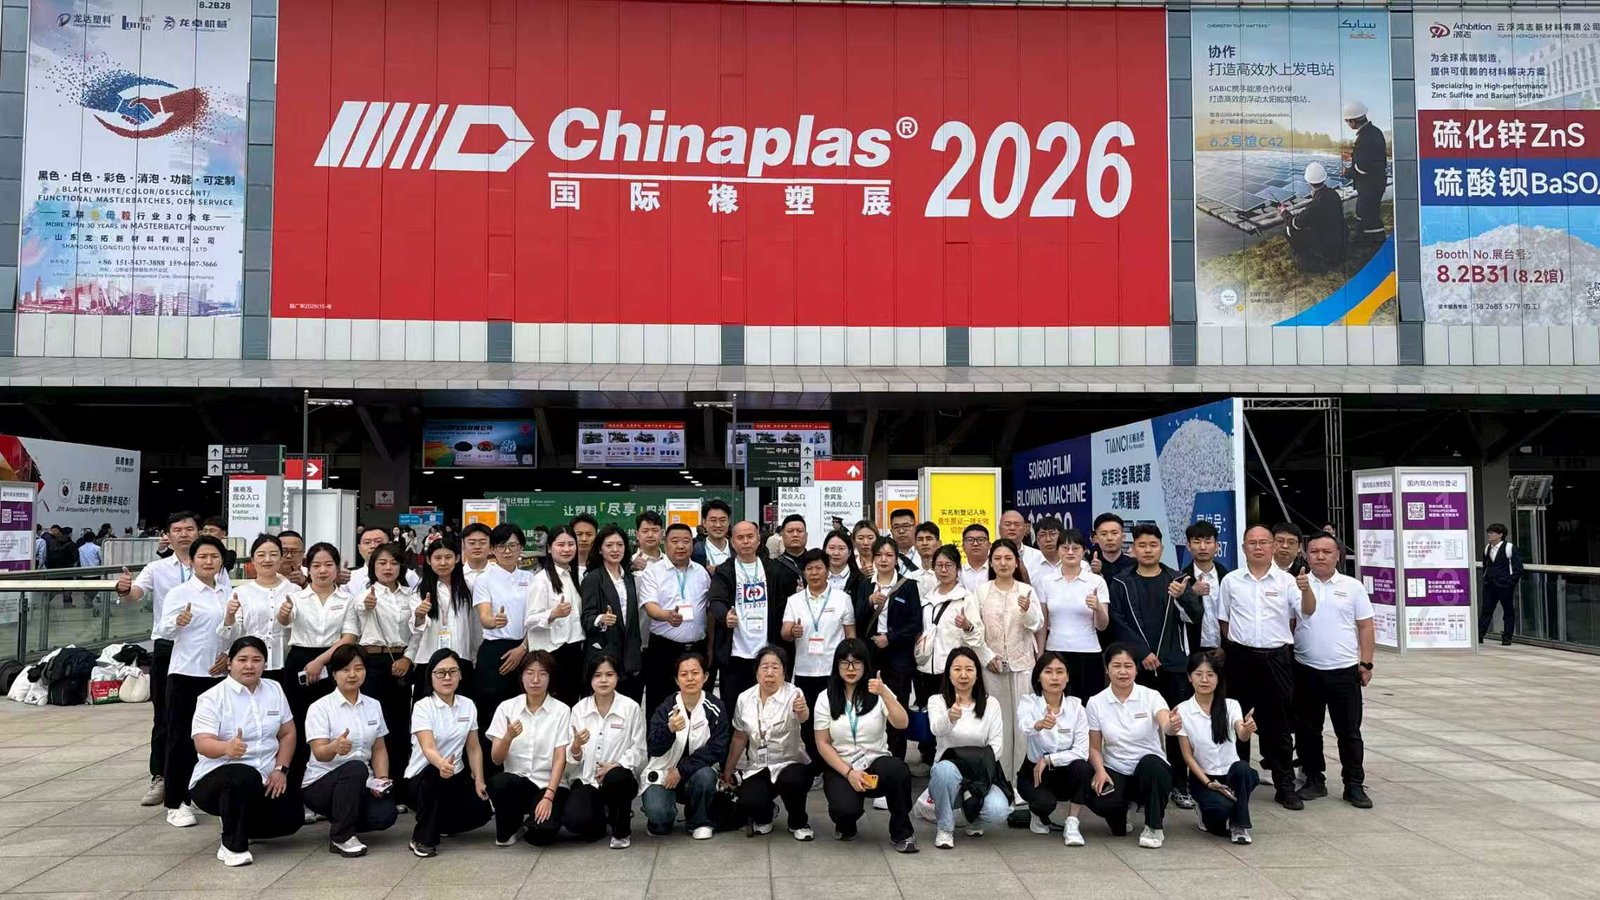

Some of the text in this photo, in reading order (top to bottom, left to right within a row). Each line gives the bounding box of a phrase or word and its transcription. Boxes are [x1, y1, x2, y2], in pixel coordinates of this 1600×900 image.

[199, 1, 231, 9] 8.2B28
[1453, 22, 1492, 31] Ambition
[1208, 44, 1236, 59] 协作
[1208, 62, 1335, 77] 打造高效水上发电站
[1431, 82, 1473, 91] Specializing
[1484, 83, 1548, 91] High-performance
[548, 107, 892, 177] Chinaplas
[924, 120, 1136, 219] 2026
[1434, 167, 1600, 197] 硫酸钡BaSO
[37, 194, 93, 203] FUNCTIONAL
[96, 196, 174, 206] MASTERBATCHES,
[198, 198, 234, 206] SERVICE
[62, 186, 211, 197] BLACK/WHITE/COLOR/DESICCANT/
[550, 180, 891, 217] 国际橡塑展
[130, 222, 191, 231] MASTERBATCH
[1436, 249, 1469, 259] Booth
[1437, 264, 1509, 283] 8.2B31
[1052, 454, 1071, 476] FILM
[1101, 463, 1151, 487] 发挥非金属资源
[1017, 482, 1087, 506] BLOWING MACHINE
[1112, 491, 1140, 510] 无限潜能
